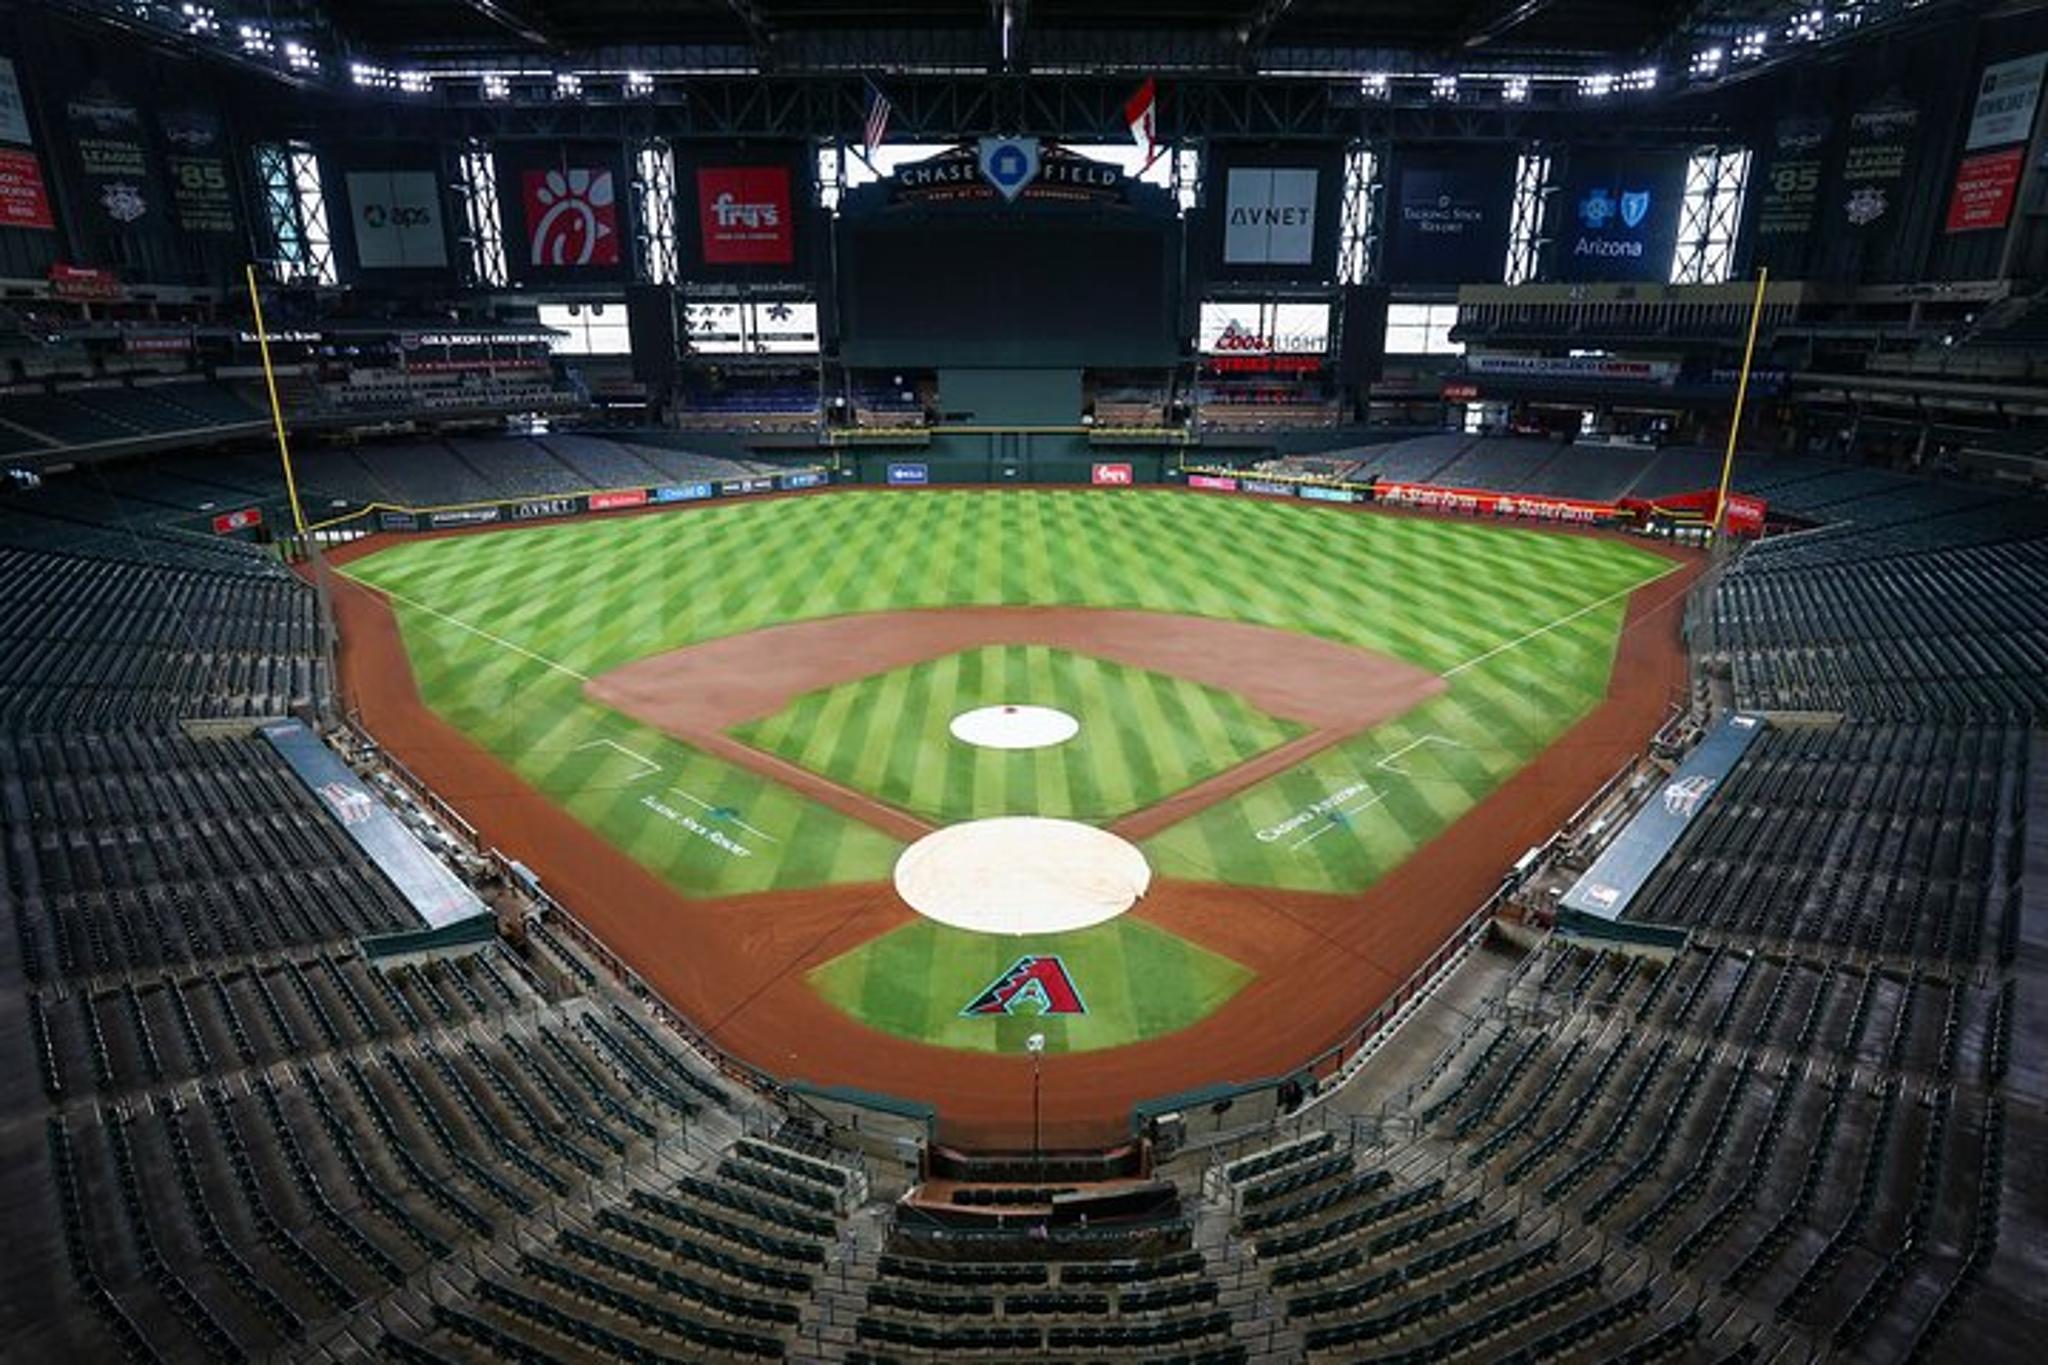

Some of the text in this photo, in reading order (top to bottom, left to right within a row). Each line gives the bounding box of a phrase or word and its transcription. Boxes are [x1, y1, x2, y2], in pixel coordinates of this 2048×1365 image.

[900, 163, 1118, 187] CHASE FIELD
[391, 206, 431, 228] aps
[1230, 205, 1310, 227] AVNET
[1573, 235, 1643, 257] Arizona
[1276, 335, 1326, 352] LIGHT
